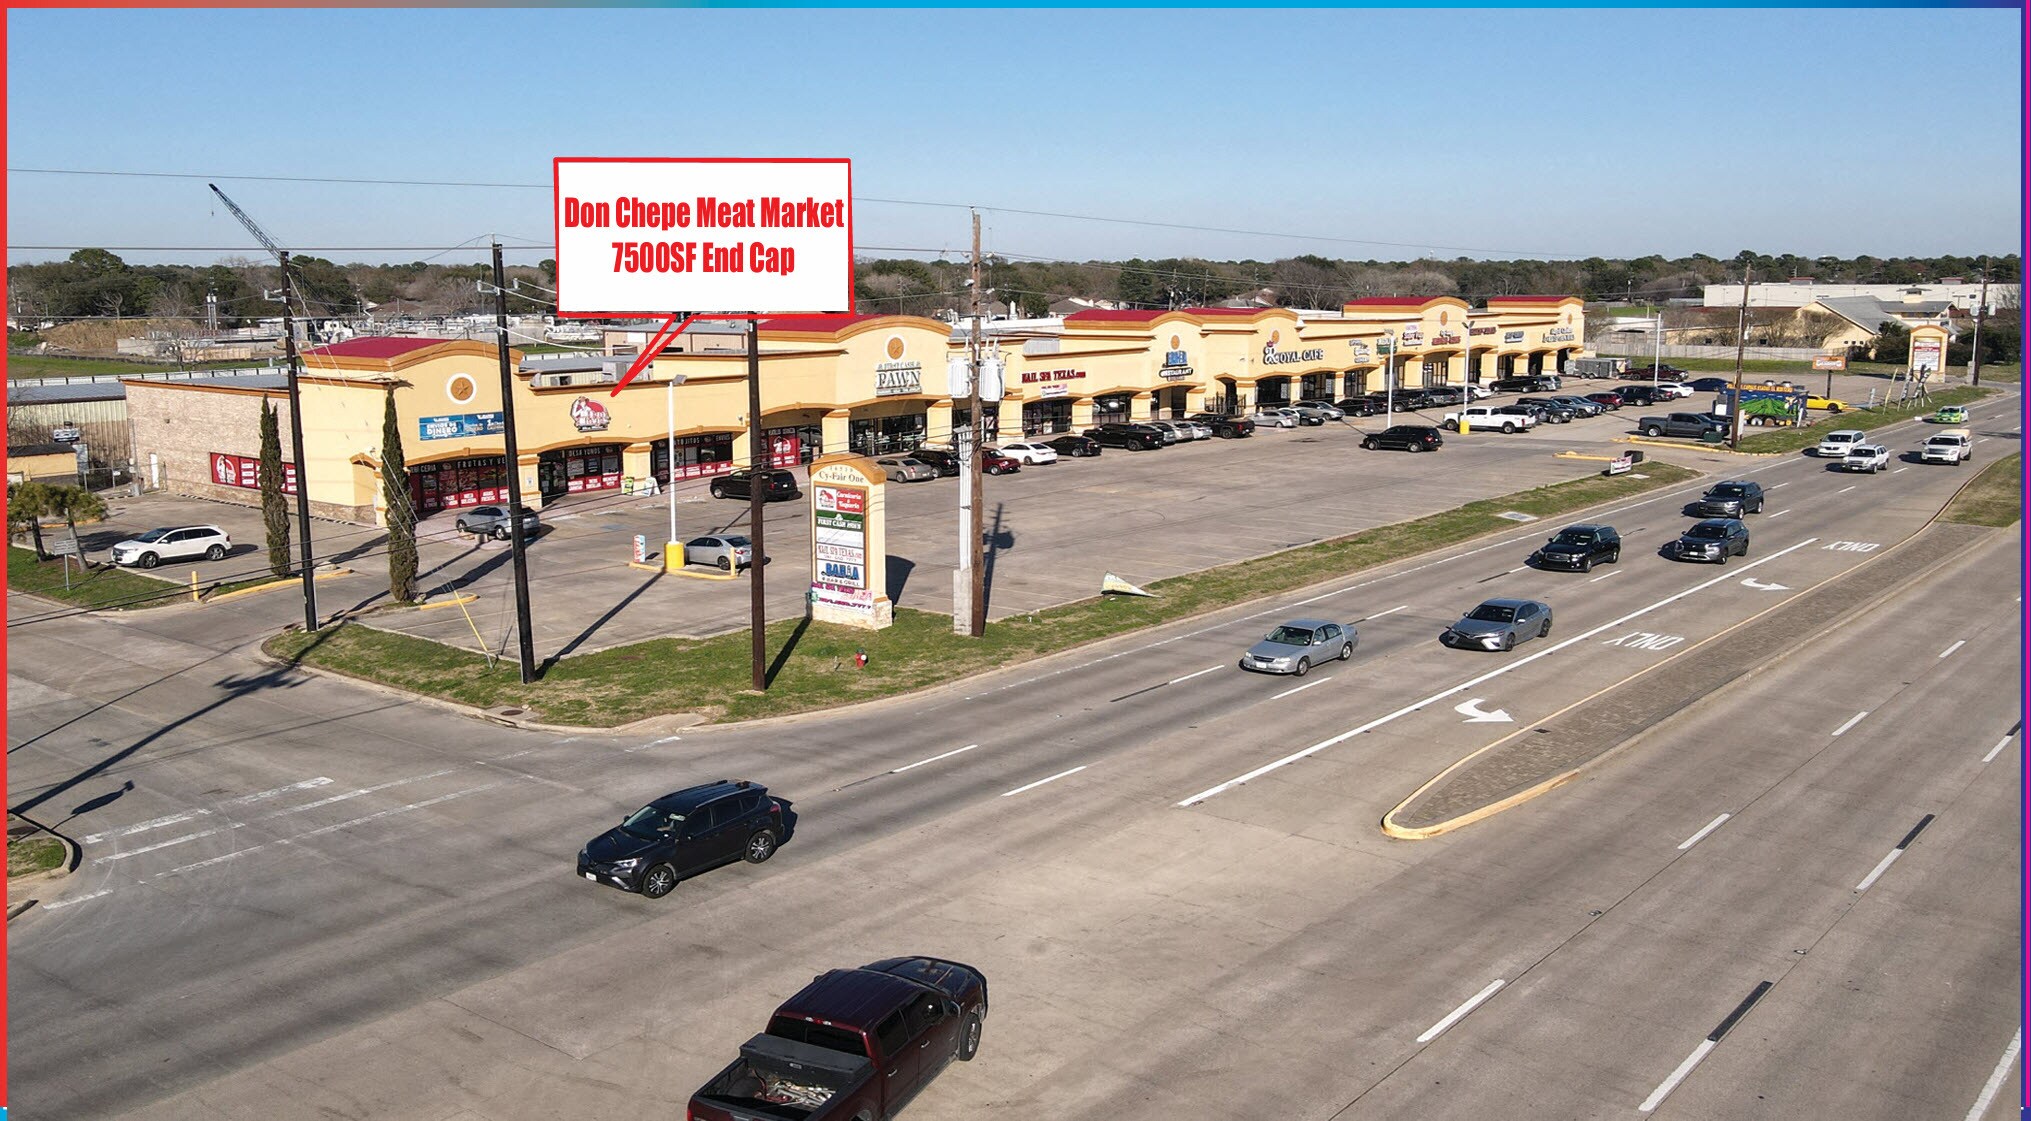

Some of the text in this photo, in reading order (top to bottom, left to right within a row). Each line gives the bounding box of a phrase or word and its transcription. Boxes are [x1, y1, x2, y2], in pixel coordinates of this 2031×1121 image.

[878, 371, 921, 387] PAWN
[1022, 373, 1038, 384] NAIL
[426, 426, 458, 436] DINERO
[819, 470, 865, 483] Cy-Fair One
[1822, 540, 1880, 553] ONLY
[1602, 631, 1685, 650] ONLY
